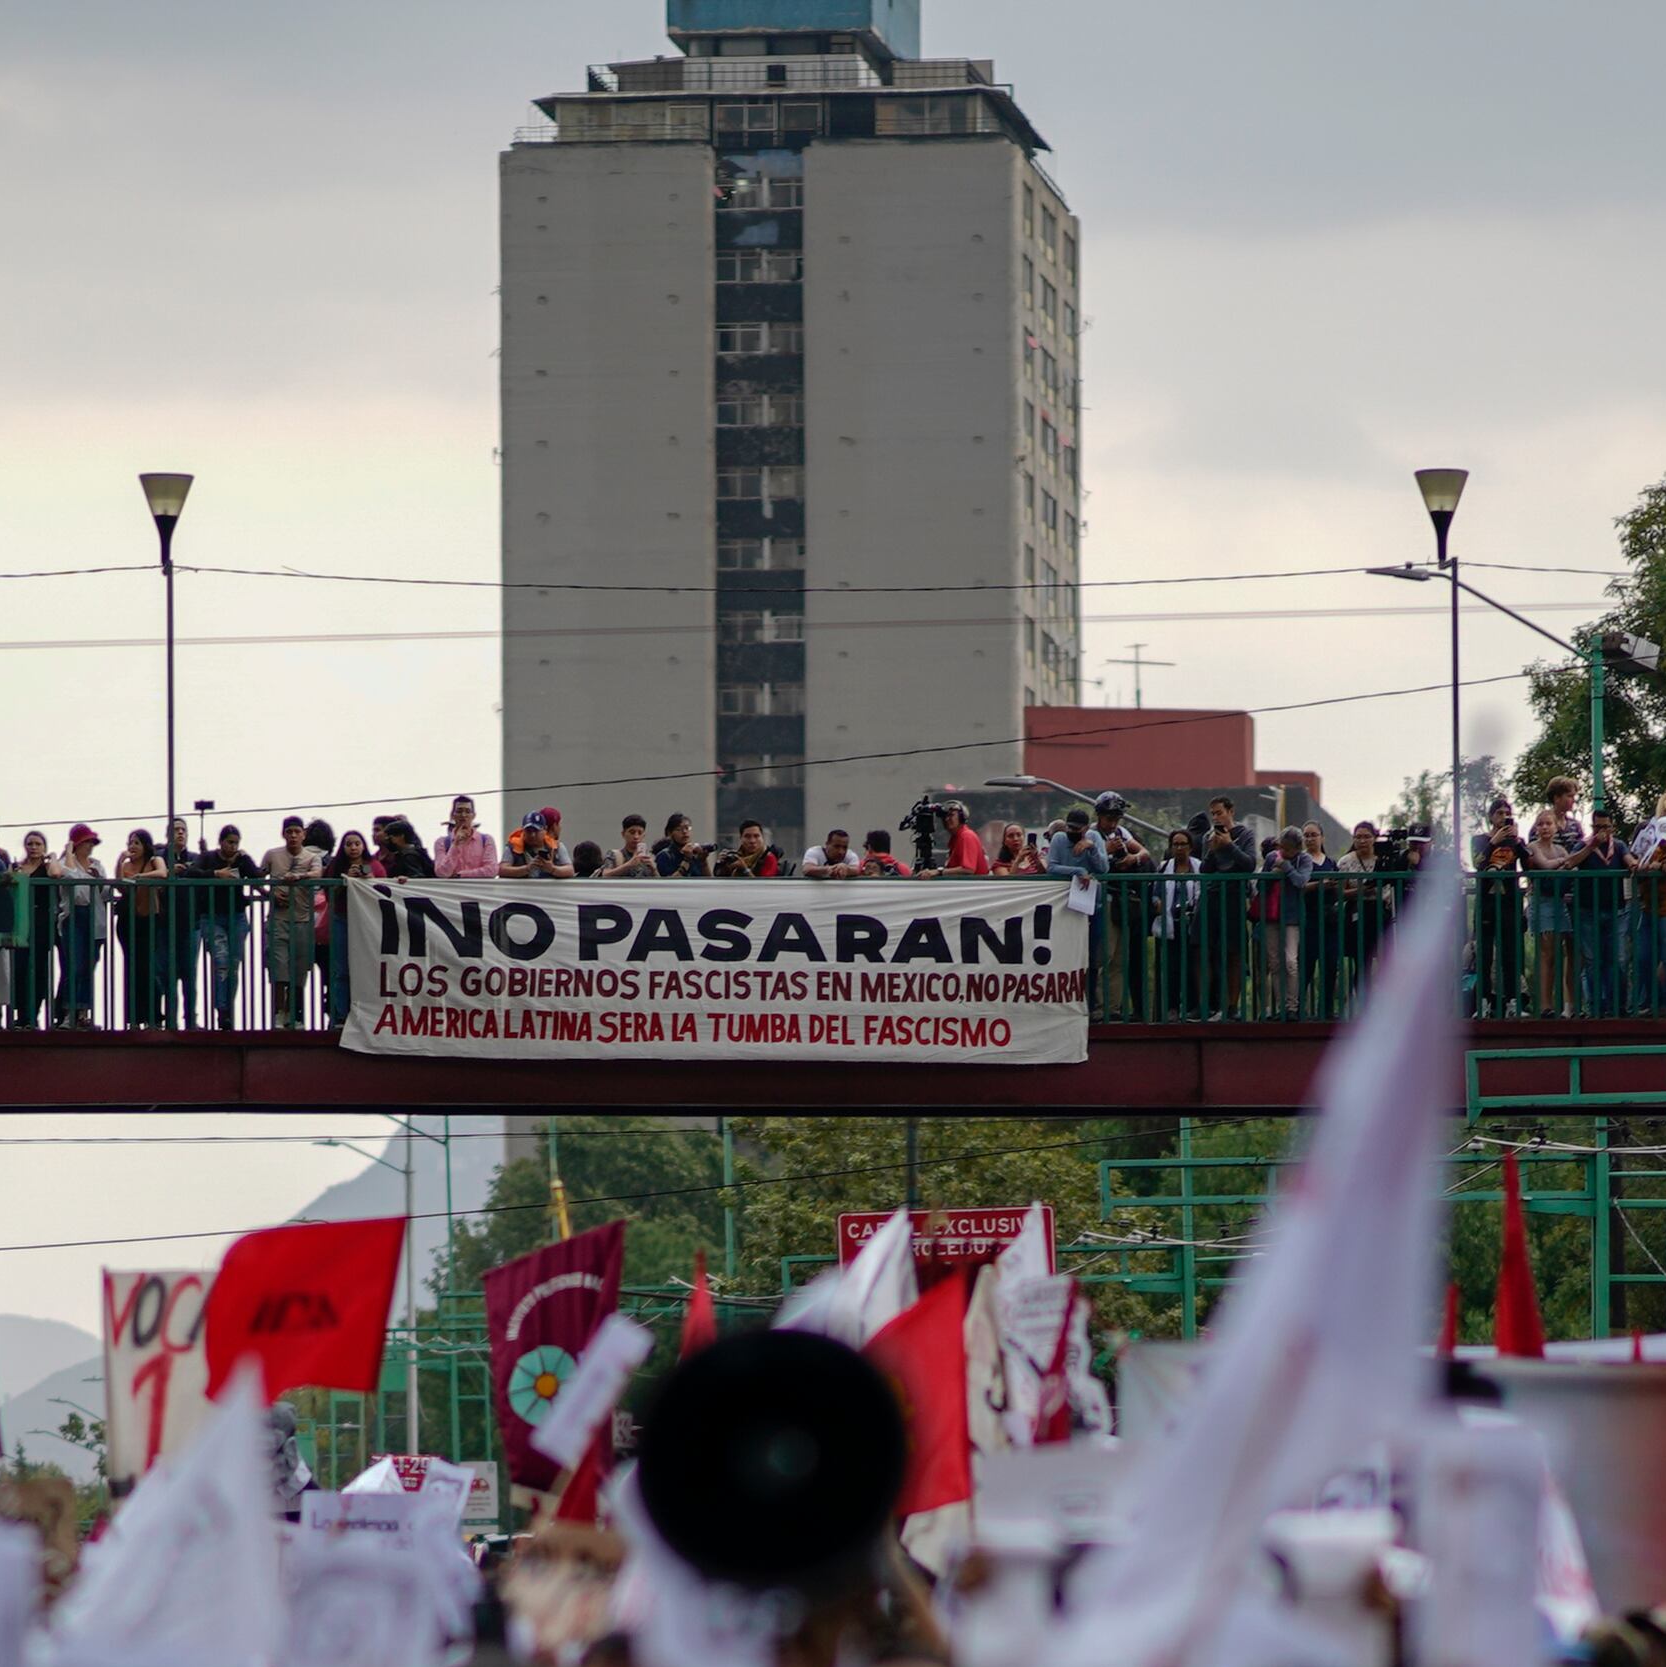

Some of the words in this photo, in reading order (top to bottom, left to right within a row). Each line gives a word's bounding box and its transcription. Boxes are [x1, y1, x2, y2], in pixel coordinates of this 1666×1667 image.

[373, 884, 555, 961] ¡NO
[578, 903, 1052, 965] PASARAN!
[379, 961, 448, 998] LOS
[460, 966, 640, 1000] GOBIERNOS
[648, 970, 808, 1000] FASCISTAS
[816, 971, 852, 1000] EN
[966, 972, 995, 1003] NO
[373, 1004, 498, 1039] AMERICA
[504, 1009, 592, 1041] LATINA
[597, 1011, 664, 1043] SERA
[671, 1012, 698, 1042] LA
[707, 1012, 801, 1043] TUMBA
[809, 1014, 855, 1045] DEL
[864, 1016, 1011, 1047] FASCISMO
